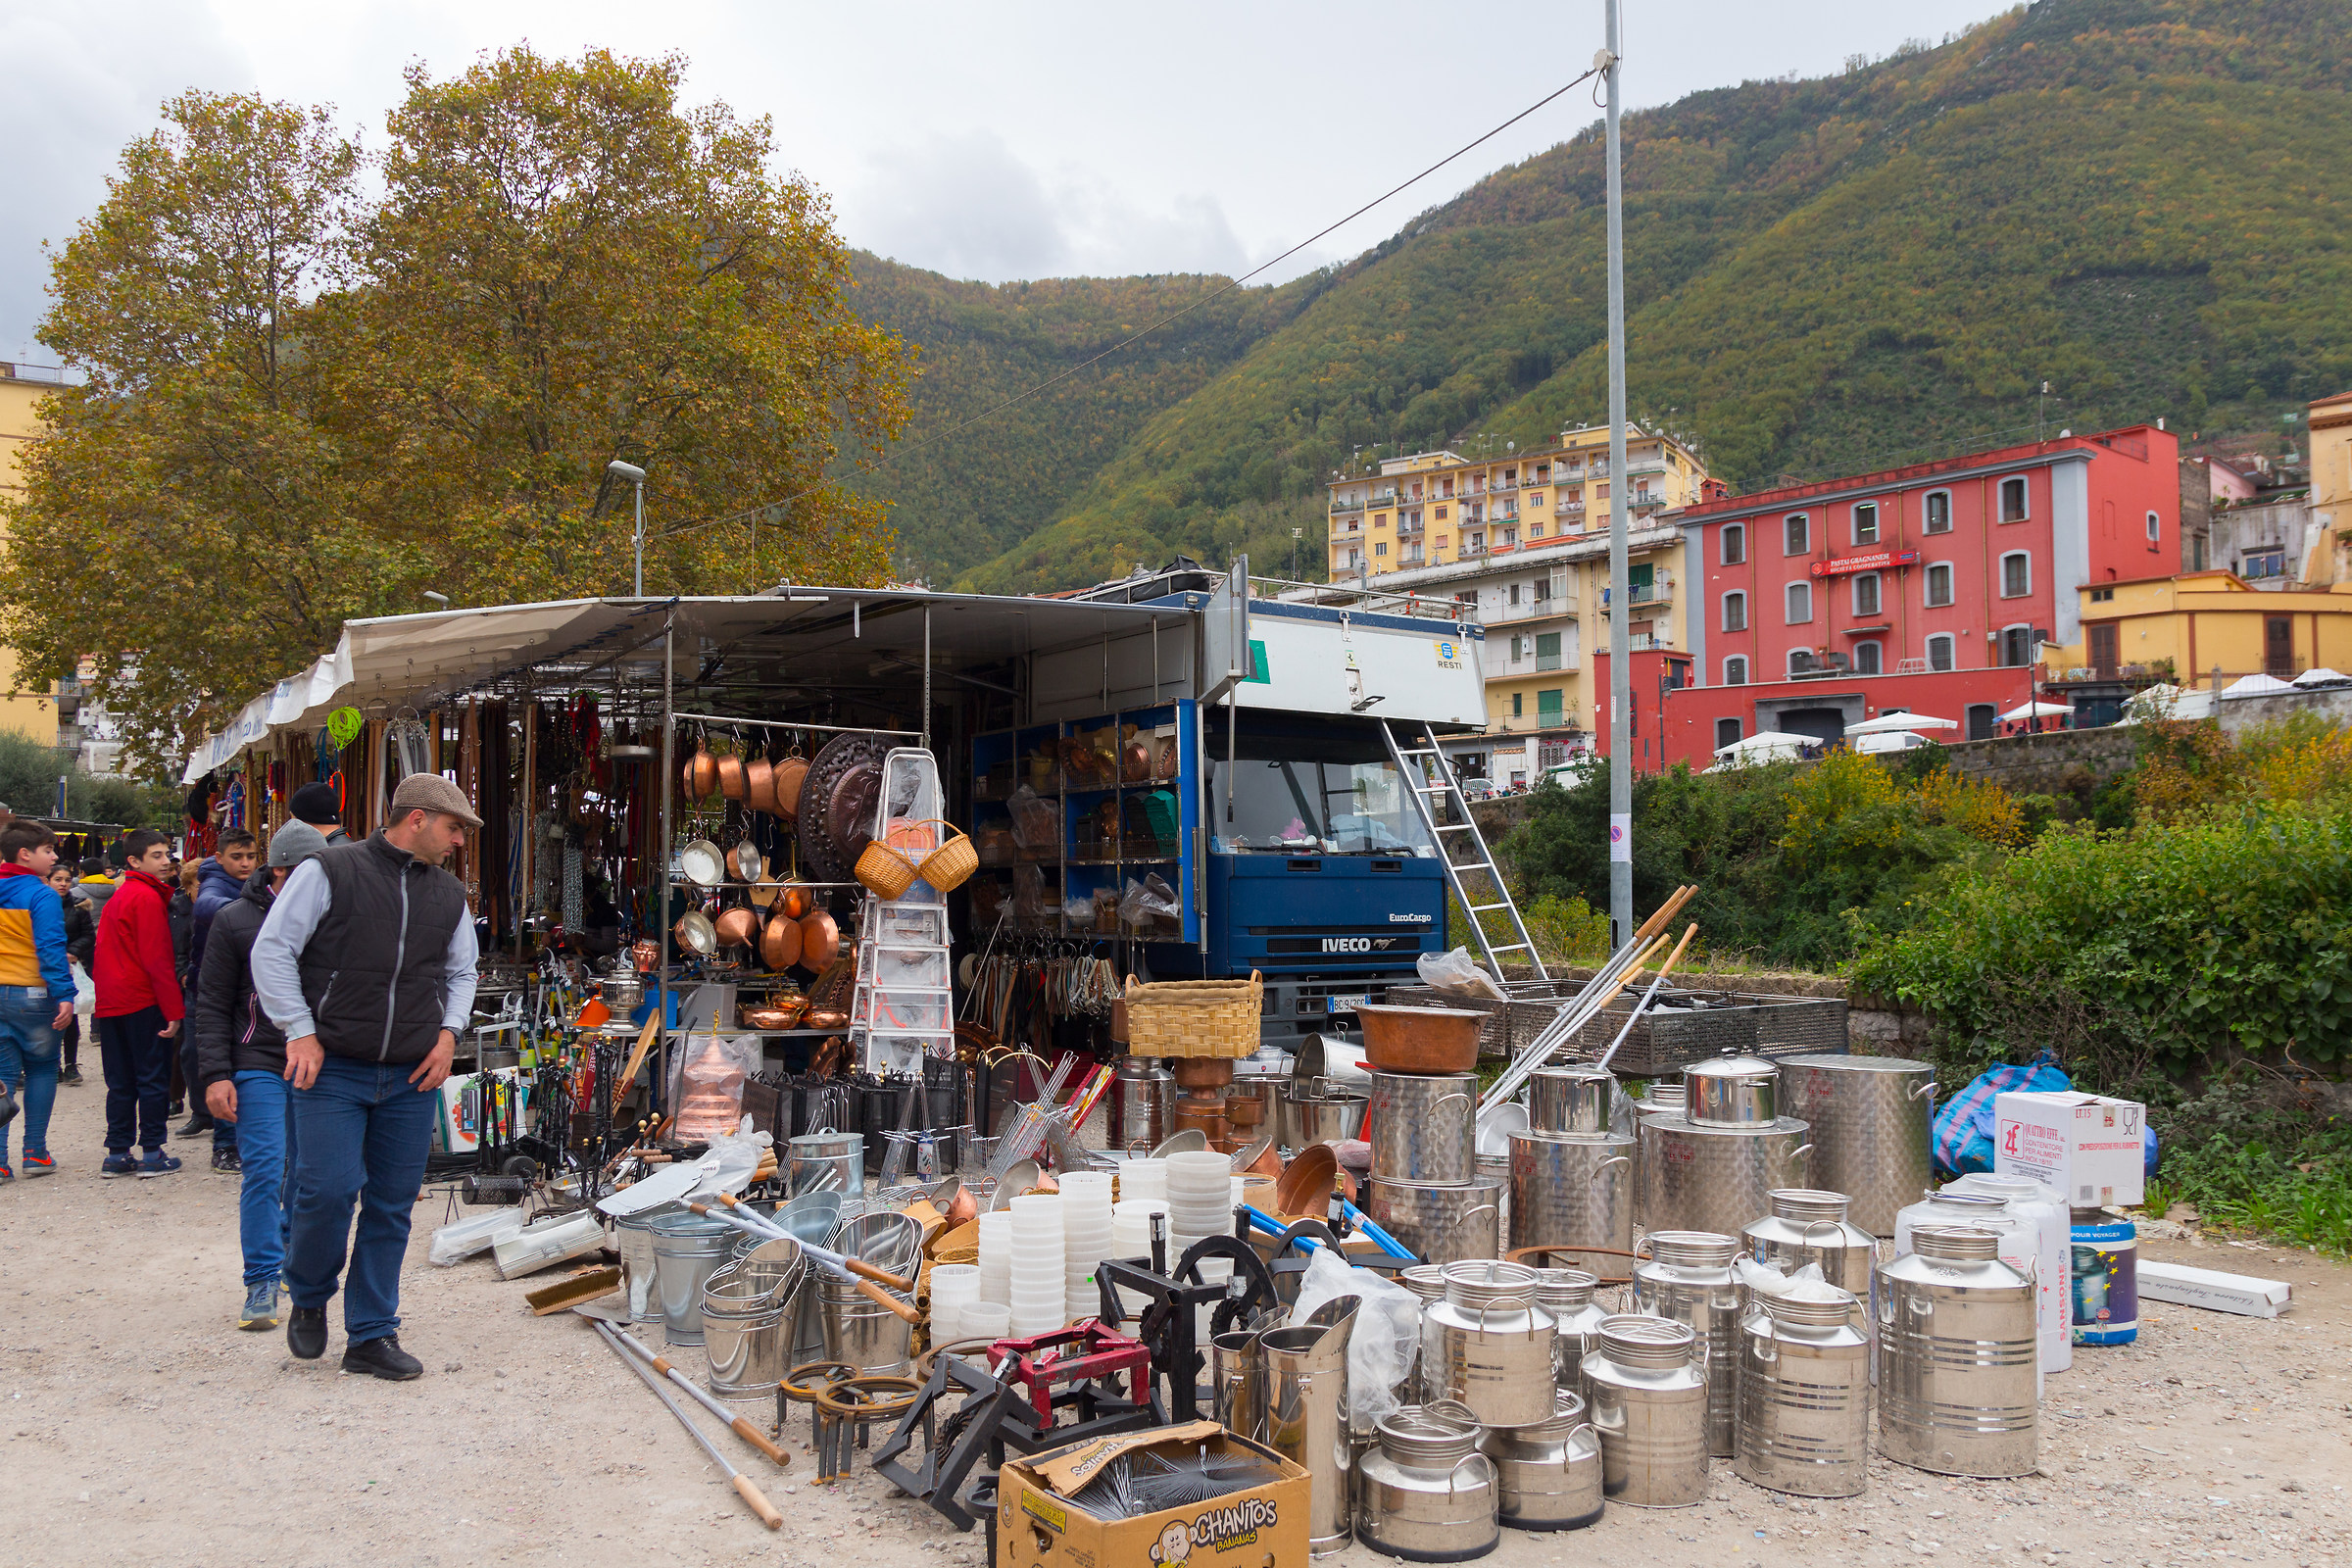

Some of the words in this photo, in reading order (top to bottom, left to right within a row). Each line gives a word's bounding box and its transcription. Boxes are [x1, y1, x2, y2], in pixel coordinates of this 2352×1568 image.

[1831, 558, 1849, 567] PASTAI
[1438, 661, 1462, 669] RESTI
[1389, 912, 1432, 923] EuroCargo
[1322, 937, 1371, 953] IVECO
[2025, 1138, 2064, 1152] CONTENITORE
[2025, 1147, 2036, 1155] PER
[2036, 1149, 2062, 1160] ALIMENTI
[1195, 1497, 1277, 1546] CHANITOS
[1216, 1531, 1258, 1553] BANANAS
